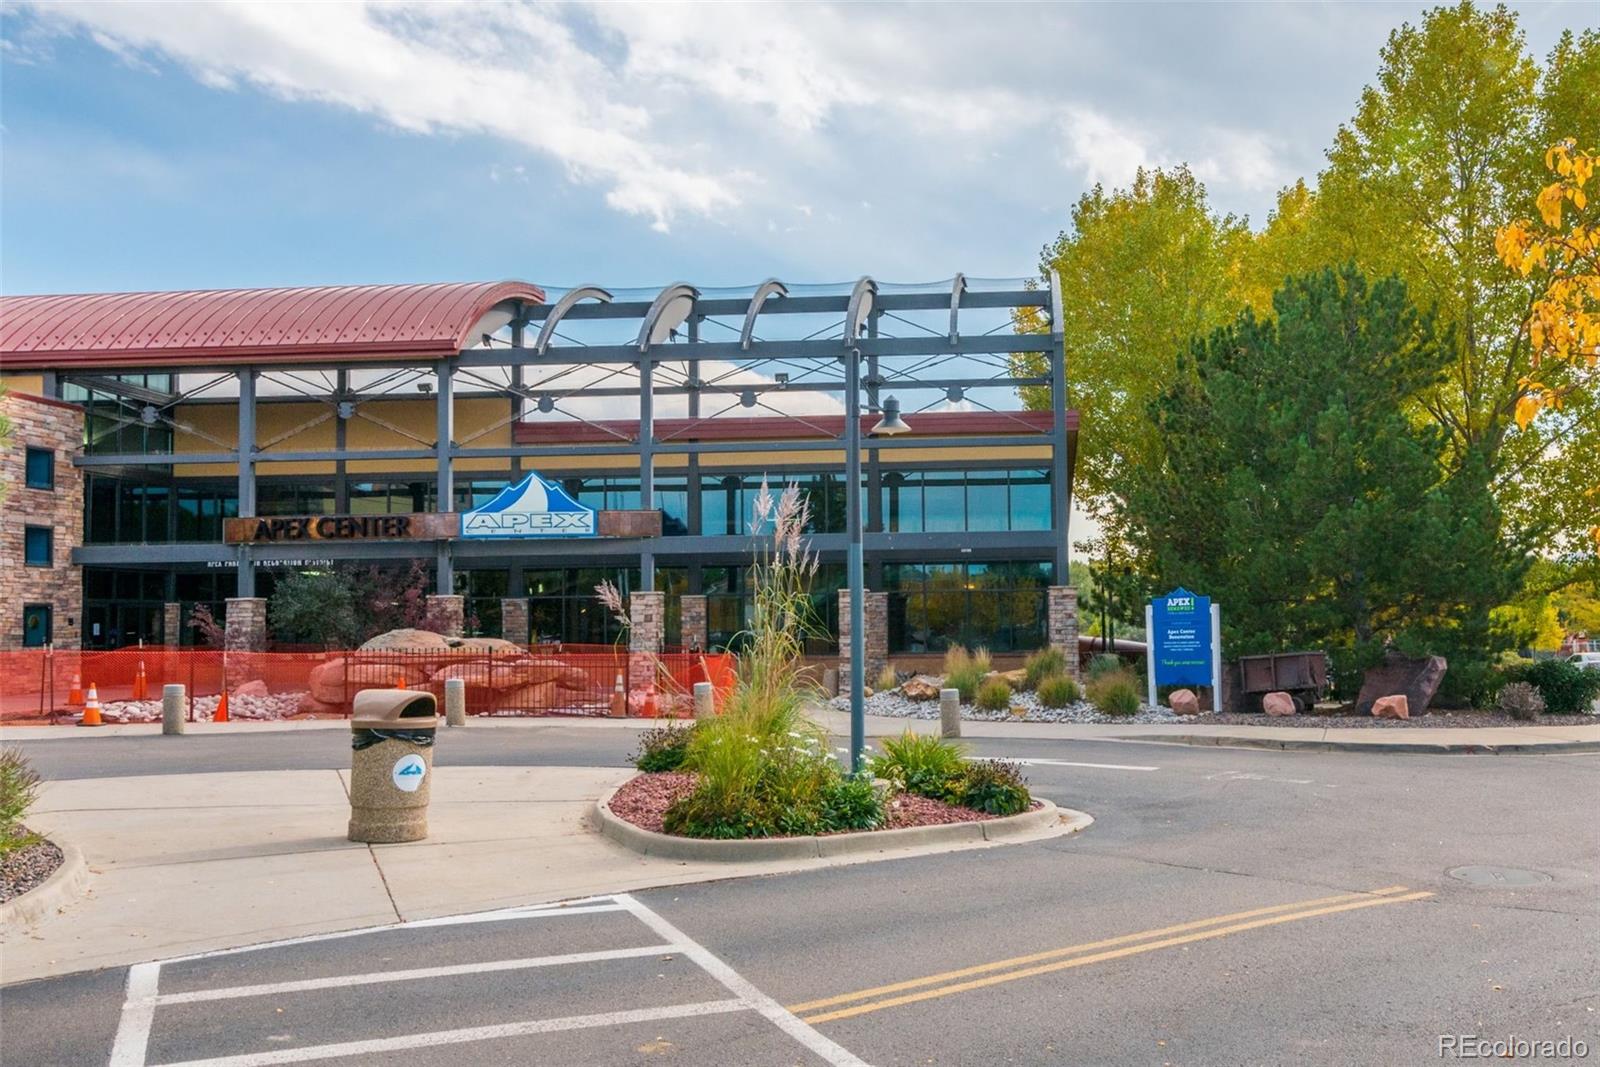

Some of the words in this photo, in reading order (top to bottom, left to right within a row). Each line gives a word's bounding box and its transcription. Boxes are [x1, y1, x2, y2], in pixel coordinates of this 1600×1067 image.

[466, 513, 590, 528] APEX
[254, 518, 312, 541] APEX
[315, 516, 412, 539] CENTER
[1167, 597, 1190, 606] APEX
